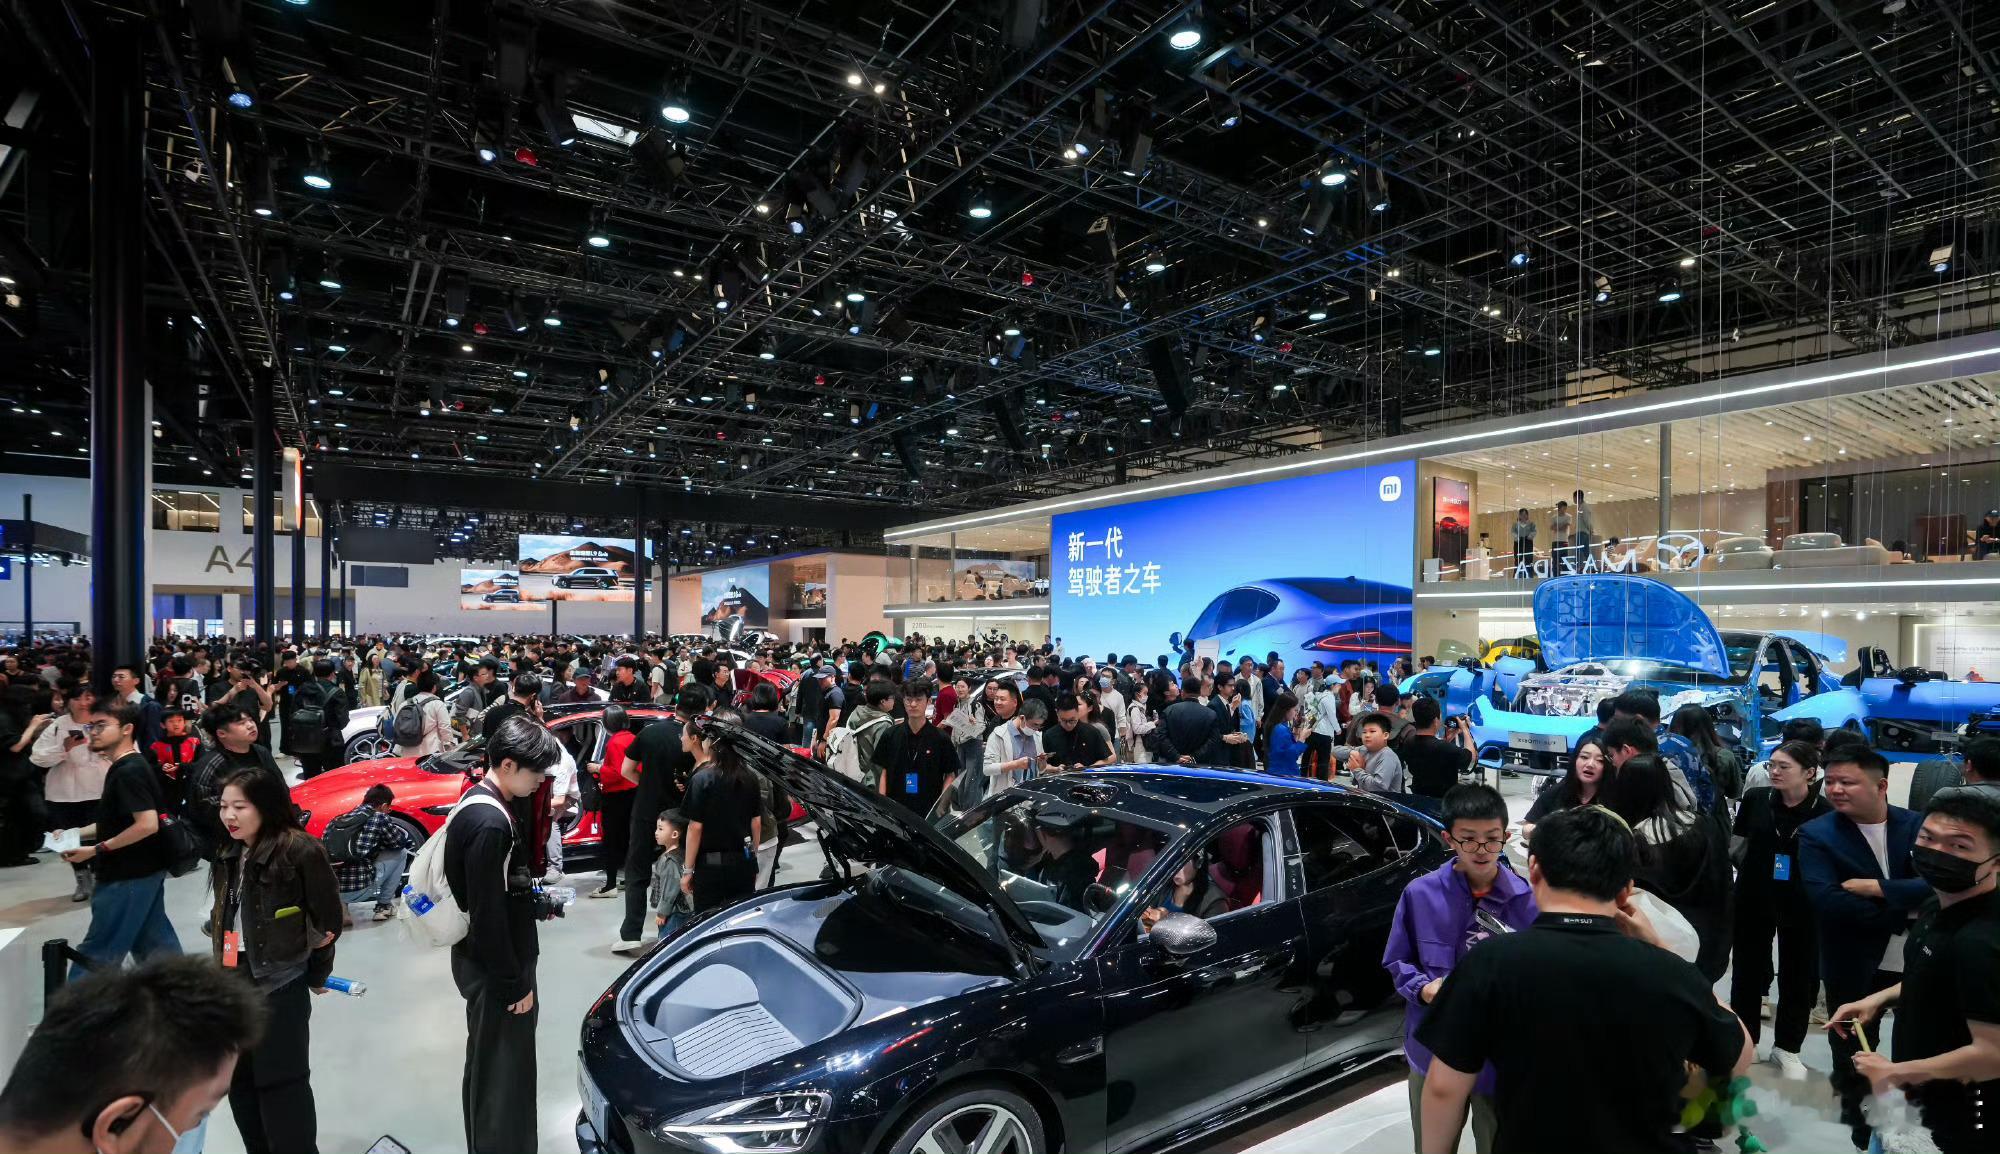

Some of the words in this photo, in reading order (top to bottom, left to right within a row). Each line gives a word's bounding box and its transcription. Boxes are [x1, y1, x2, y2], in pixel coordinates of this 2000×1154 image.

[205, 545, 254, 574] A4
[1068, 526, 1123, 561] 新一代
[1068, 561, 1161, 597] 驾驶者之车
